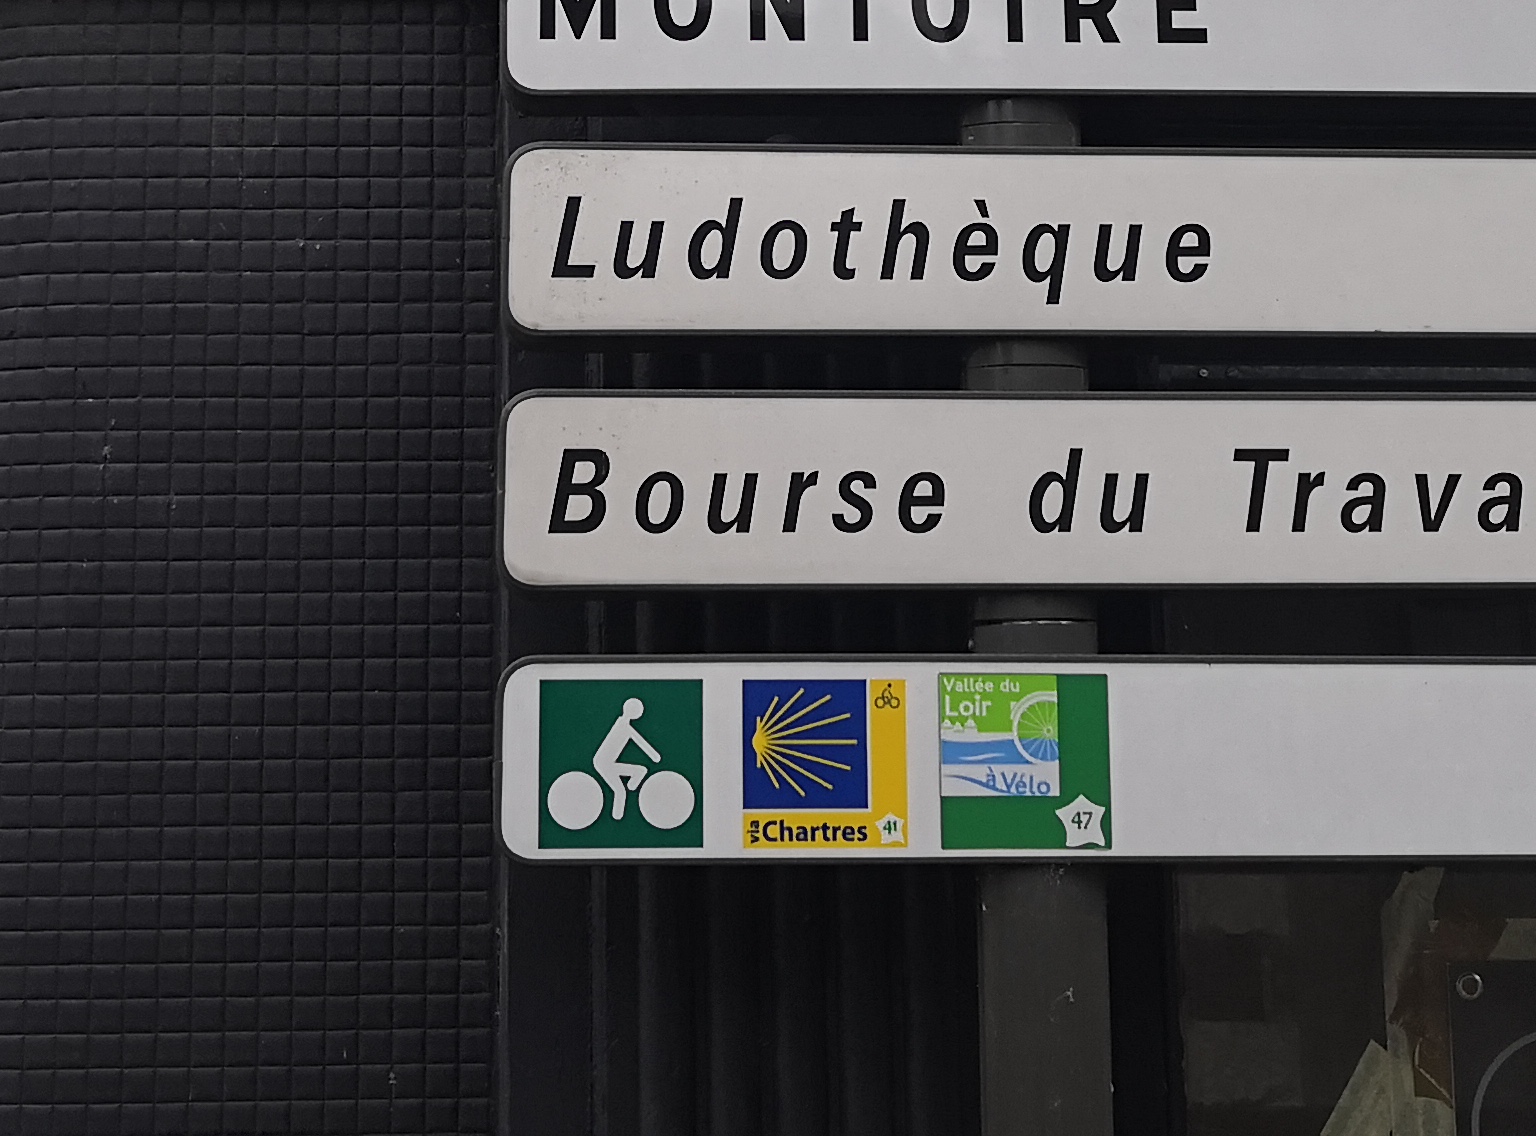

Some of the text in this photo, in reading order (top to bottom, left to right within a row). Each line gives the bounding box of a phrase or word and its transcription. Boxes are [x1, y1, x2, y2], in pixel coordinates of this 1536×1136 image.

[551, 195, 1211, 305] Ludothèque
[548, 448, 947, 533] Bourse
[1028, 447, 1150, 533] du
[943, 677, 1020, 692] Vallée du
[945, 695, 992, 716] Loir
[985, 766, 1051, 795] à Vélo
[748, 819, 867, 844] via Chartres
[882, 820, 897, 835] 41
[1071, 811, 1093, 830] 47
